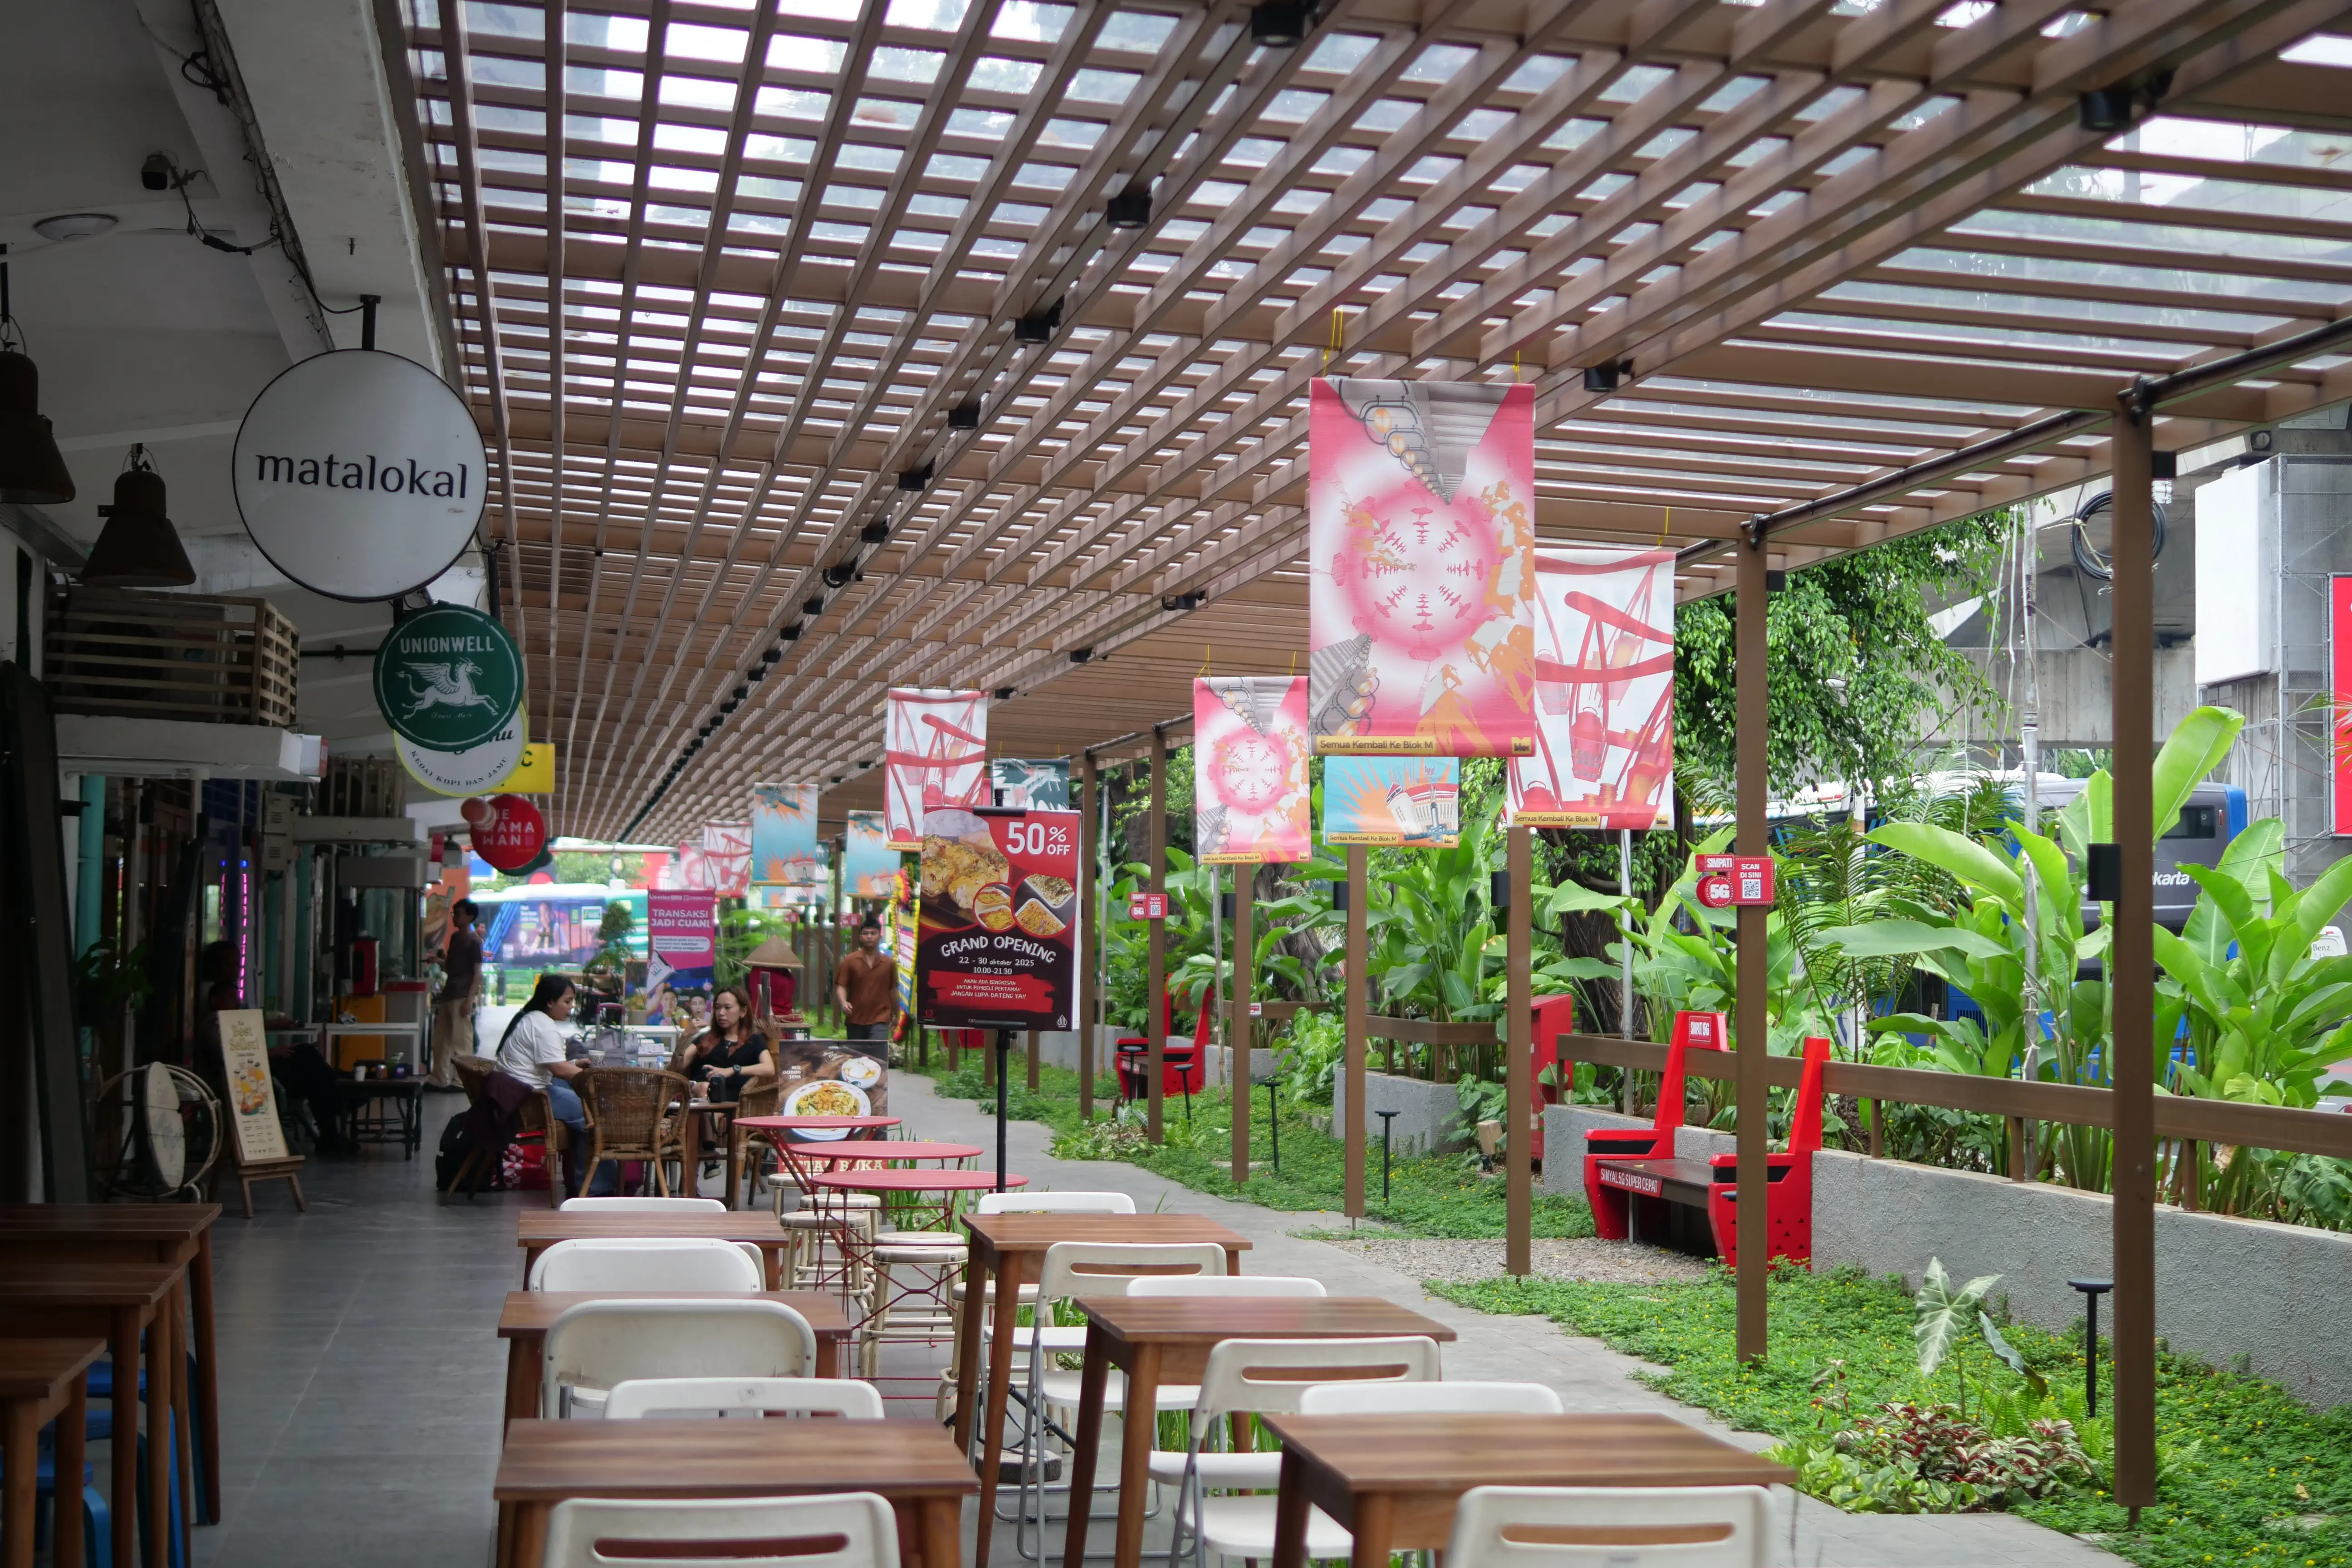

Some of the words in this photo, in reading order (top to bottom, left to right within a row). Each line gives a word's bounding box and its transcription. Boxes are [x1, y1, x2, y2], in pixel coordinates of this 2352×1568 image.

[255, 454, 467, 499] matalokal
[400, 636, 495, 654] UNIONWELL
[1320, 740, 1350, 749] Semua
[1352, 740, 1387, 749] Kembali
[1390, 740, 1401, 749] Ke
[1403, 740, 1423, 749] Blok
[1425, 740, 1433, 749] M
[411, 750, 433, 777] KEDAI
[436, 775, 461, 786] KOPI
[466, 776, 485, 786] DAN
[488, 756, 508, 778] JAMU
[497, 821, 535, 833] AMA
[482, 835, 521, 846] WAN
[1047, 844, 1071, 855] OFF
[1706, 858, 1733, 868] SIMPATI
[1710, 883, 1730, 899] 5G
[652, 908, 709, 918] TRANSAKSI
[1133, 906, 1145, 915] 5G
[651, 918, 675, 927] JADI
[941, 936, 989, 957] GRAND
[994, 936, 1057, 964] OPENING
[1014, 958, 1034, 966] 2025
[973, 966, 1012, 975] 10.00-21.30
[1690, 1021, 1703, 1035] SIMPATI
[1703, 1022, 1710, 1036] 5G
[1601, 1168, 1618, 1184] SINYAL
[1618, 1172, 1625, 1186] 5G
[1625, 1173, 1642, 1189] SUPER
[1642, 1177, 1658, 1193] CEPAT
